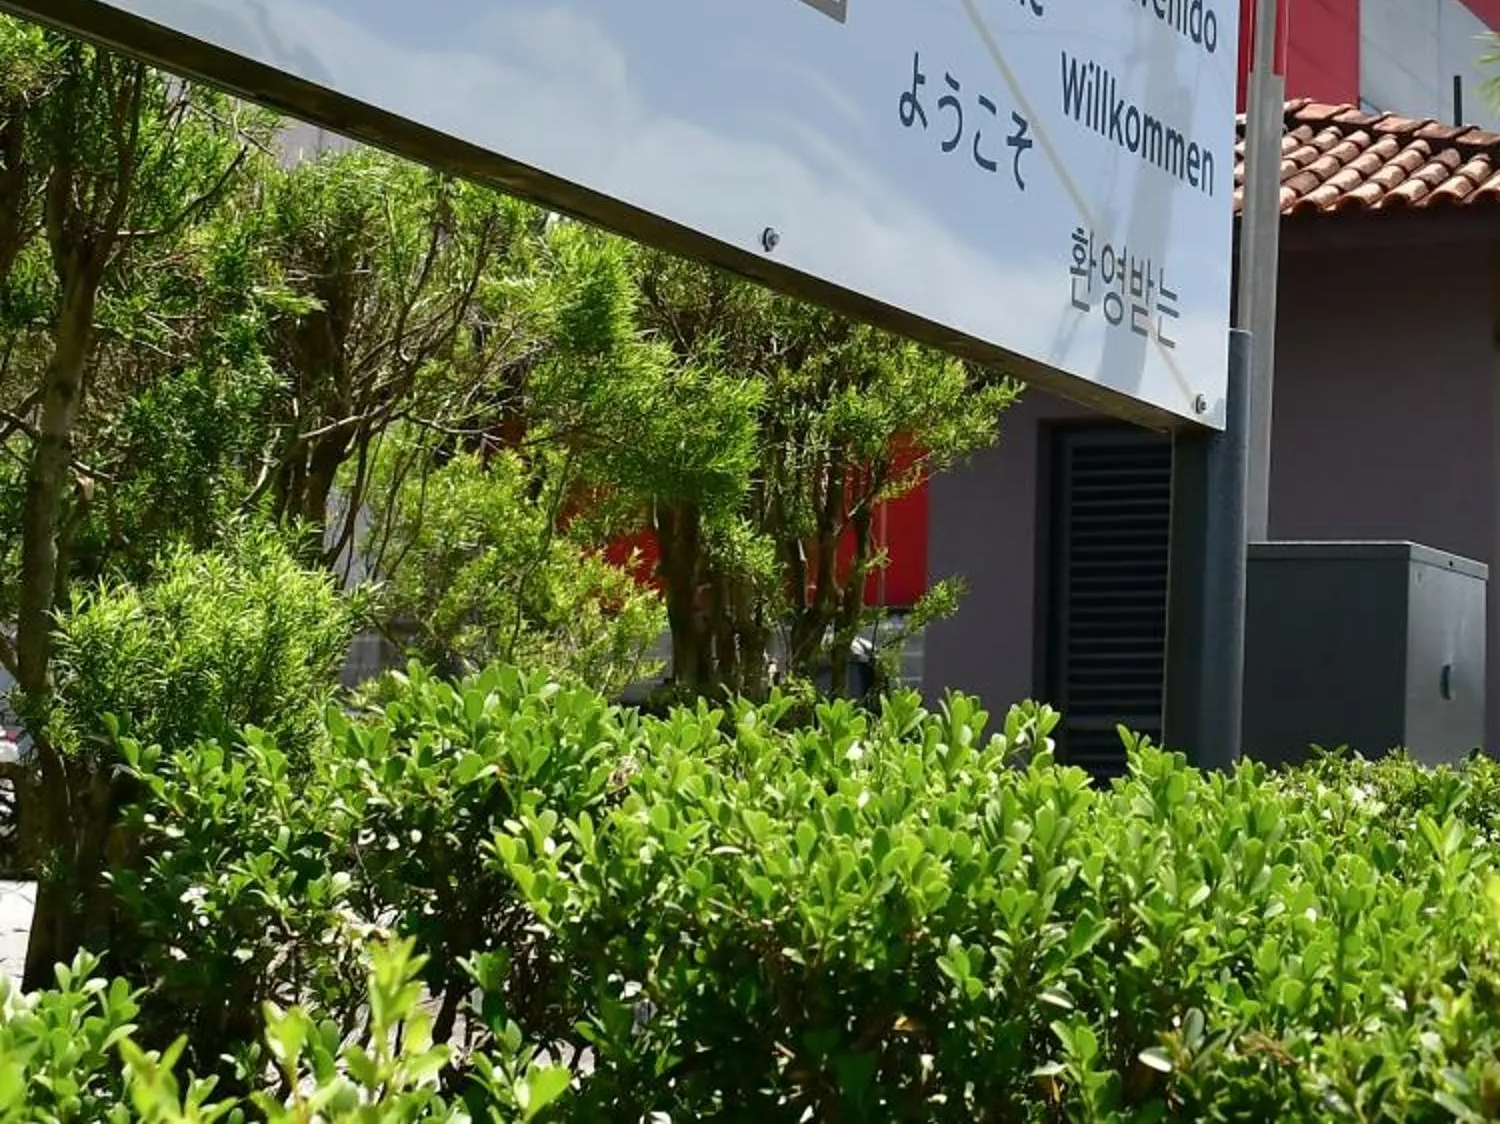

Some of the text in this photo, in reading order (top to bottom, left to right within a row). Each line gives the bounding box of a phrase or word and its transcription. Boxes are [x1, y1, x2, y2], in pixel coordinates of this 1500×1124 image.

[898, 50, 1034, 192] ようこそ
[1060, 50, 1216, 197] Willkommen
[1069, 226, 1181, 349] 환영받는
